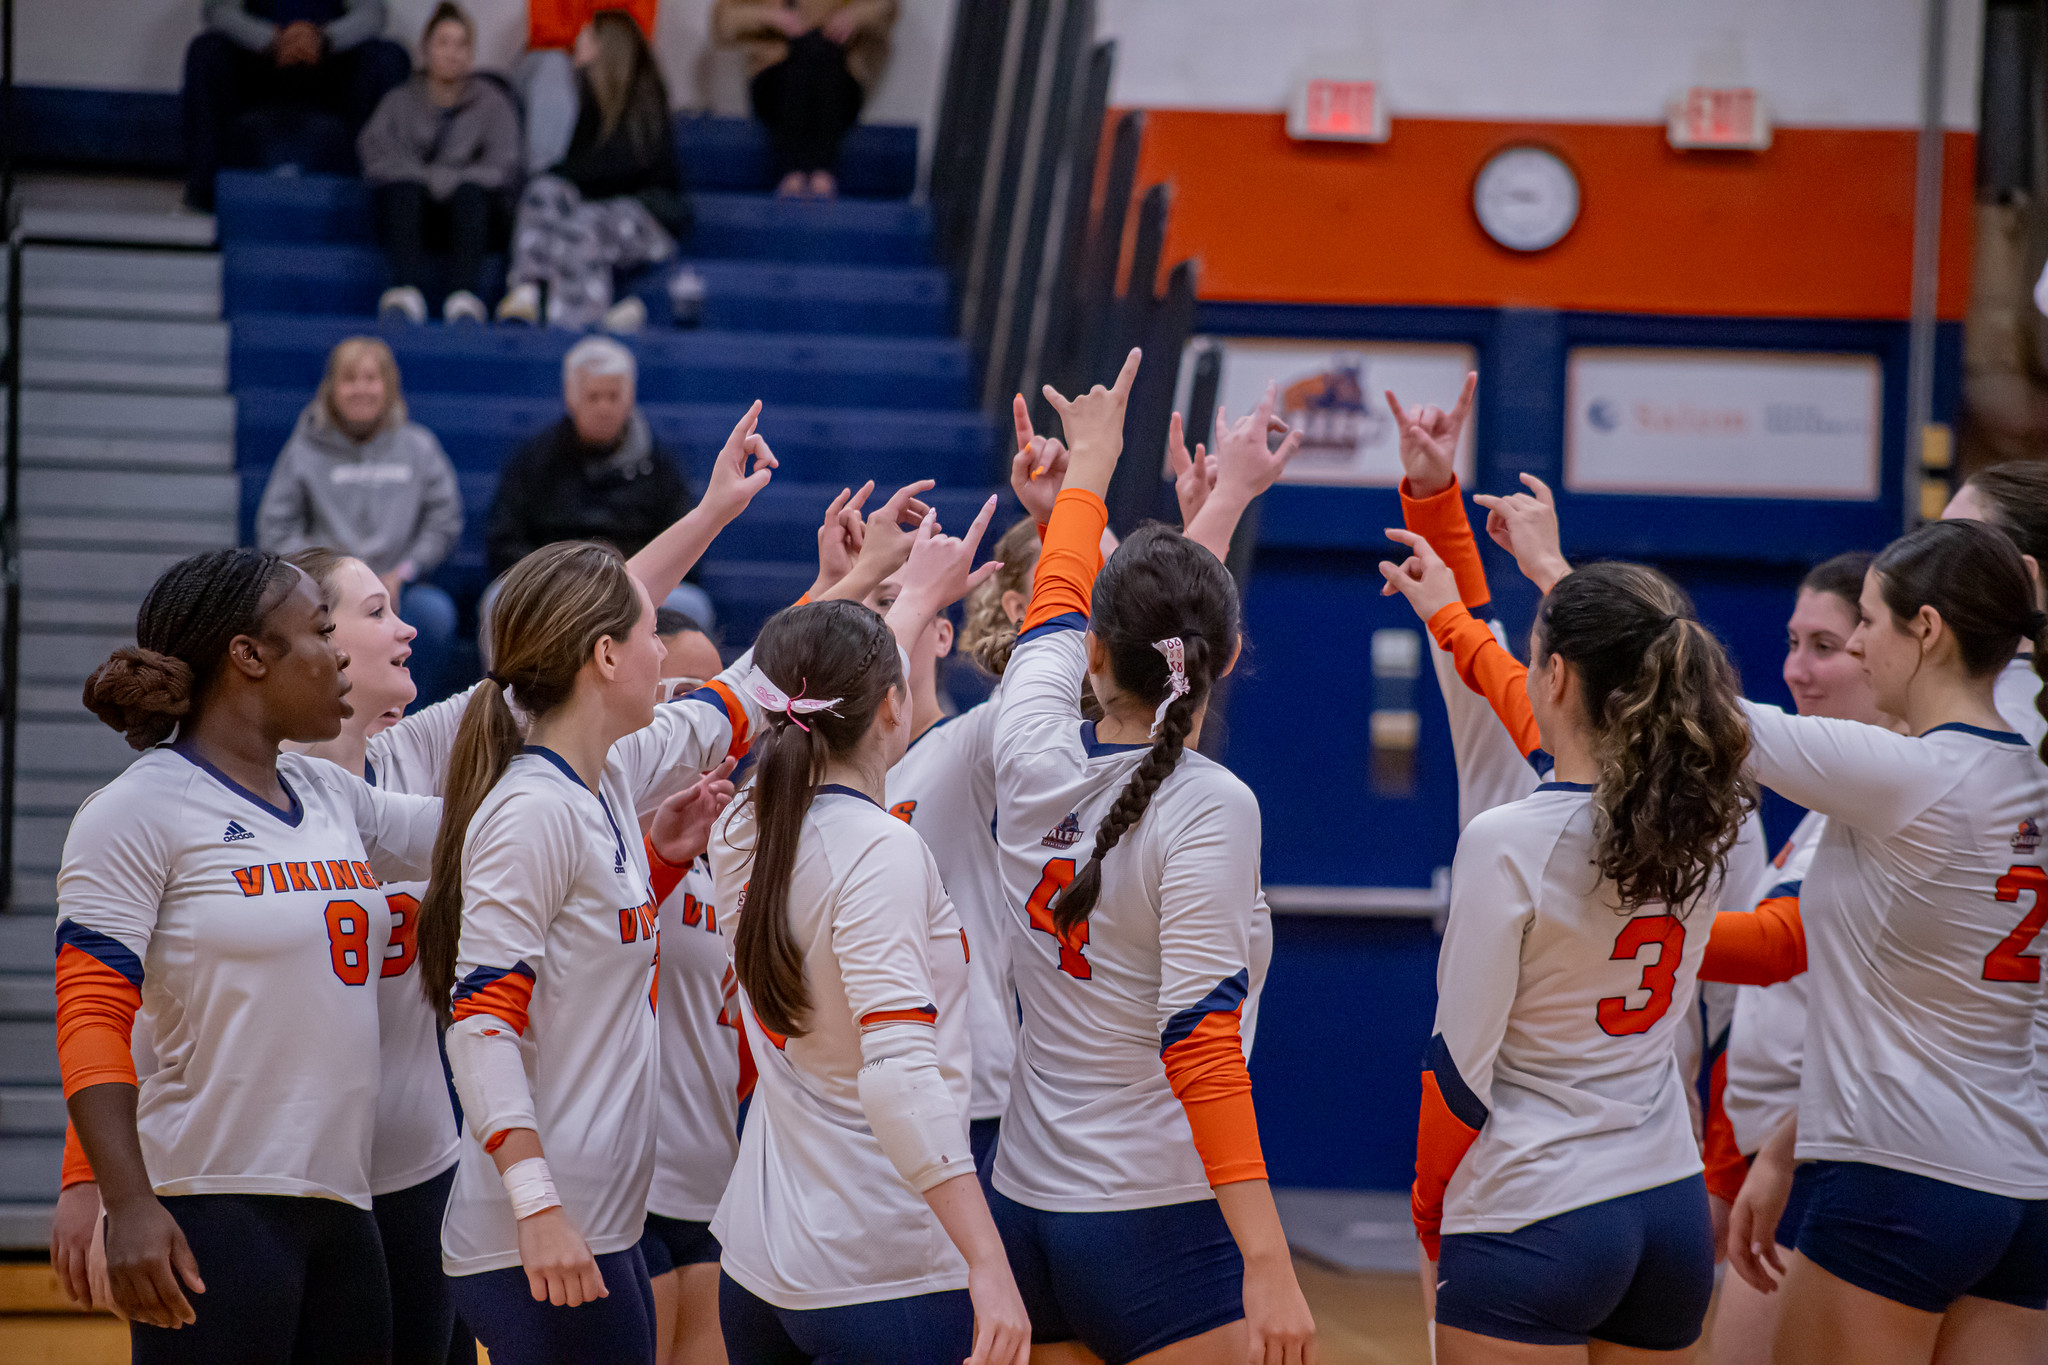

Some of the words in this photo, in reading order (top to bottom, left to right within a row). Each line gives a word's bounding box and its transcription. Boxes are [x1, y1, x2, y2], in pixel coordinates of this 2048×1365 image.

[223, 831, 256, 843] adidas
[1046, 828, 1084, 843] ALEM
[324, 900, 369, 986] 8
[1025, 857, 1092, 980] 4
[1981, 864, 2048, 983] 2
[1596, 914, 1686, 1037] 3
